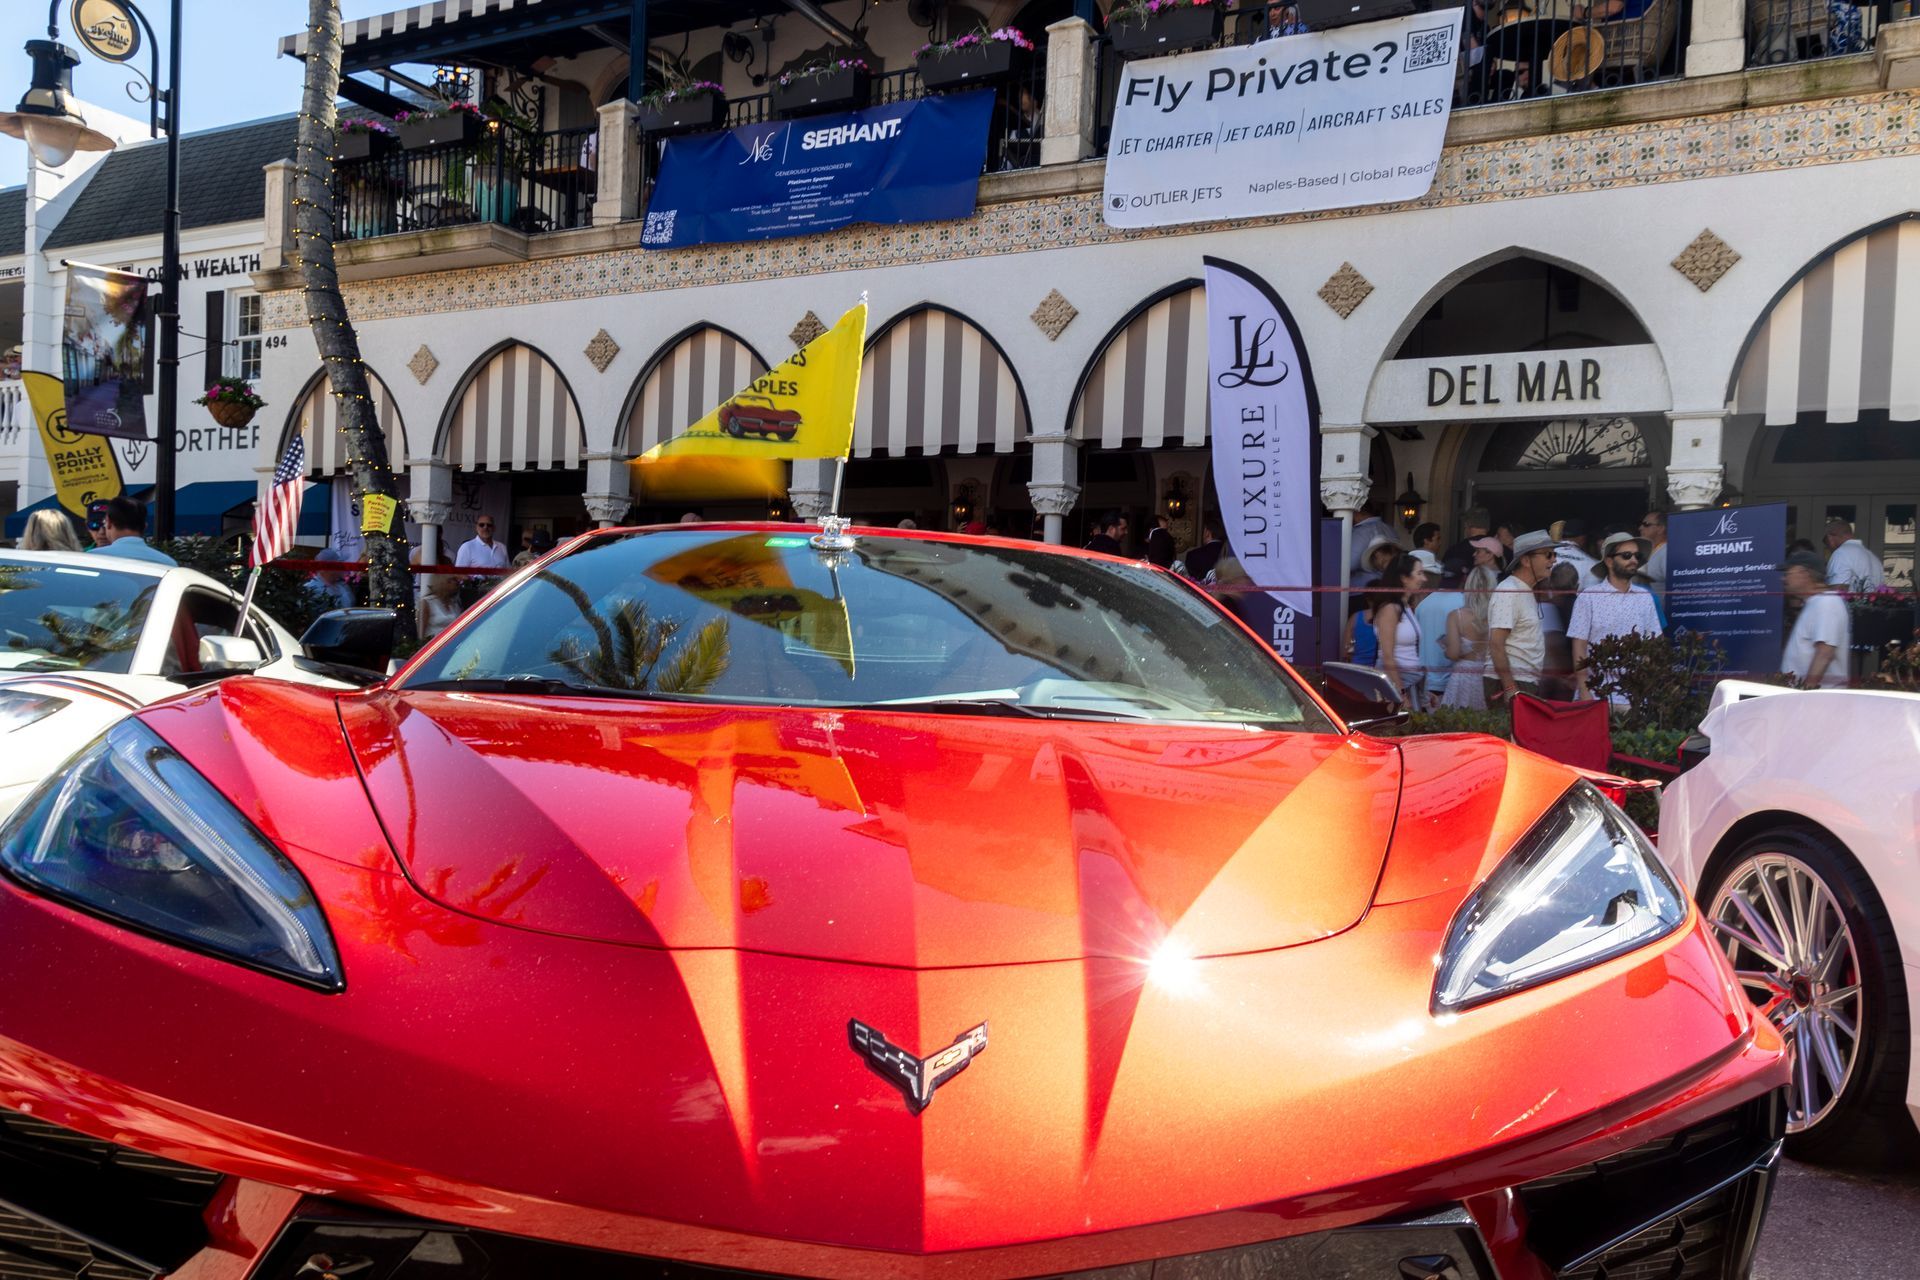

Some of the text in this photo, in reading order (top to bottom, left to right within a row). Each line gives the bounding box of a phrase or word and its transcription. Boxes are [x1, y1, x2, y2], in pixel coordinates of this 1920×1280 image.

[1125, 41, 1399, 113] Fly Private?
[801, 118, 902, 150] SERHANT.
[1118, 98, 1444, 156] JET CHARTER JET CARD AIRCRAFT SALES
[775, 167, 811, 177] GENEROUSLY
[811, 164, 844, 174] SPONSORED
[787, 176, 835, 186] Platinum Sponsor
[1249, 172, 1338, 195] Naples-Based
[1350, 167, 1394, 183] Global
[1131, 186, 1223, 209] OUTLIER JETS
[194, 253, 261, 279] WEALTH
[265, 335, 287, 349] 494
[746, 378, 798, 396] APLES
[1428, 358, 1602, 407] DEL MAR
[175, 425, 260, 452] ORTHE
[54, 446, 102, 461] RALLY
[56, 455, 104, 470] POINT
[58, 463, 106, 475] GARAGE
[1241, 405, 1268, 560] LUXURE
[1272, 436, 1282, 528] LIFESTYLE
[1695, 541, 1753, 556] SERHANT.
[1673, 567, 1705, 576] Exclusive
[1706, 564, 1743, 574] Concierge
[1273, 606, 1295, 663] SER
